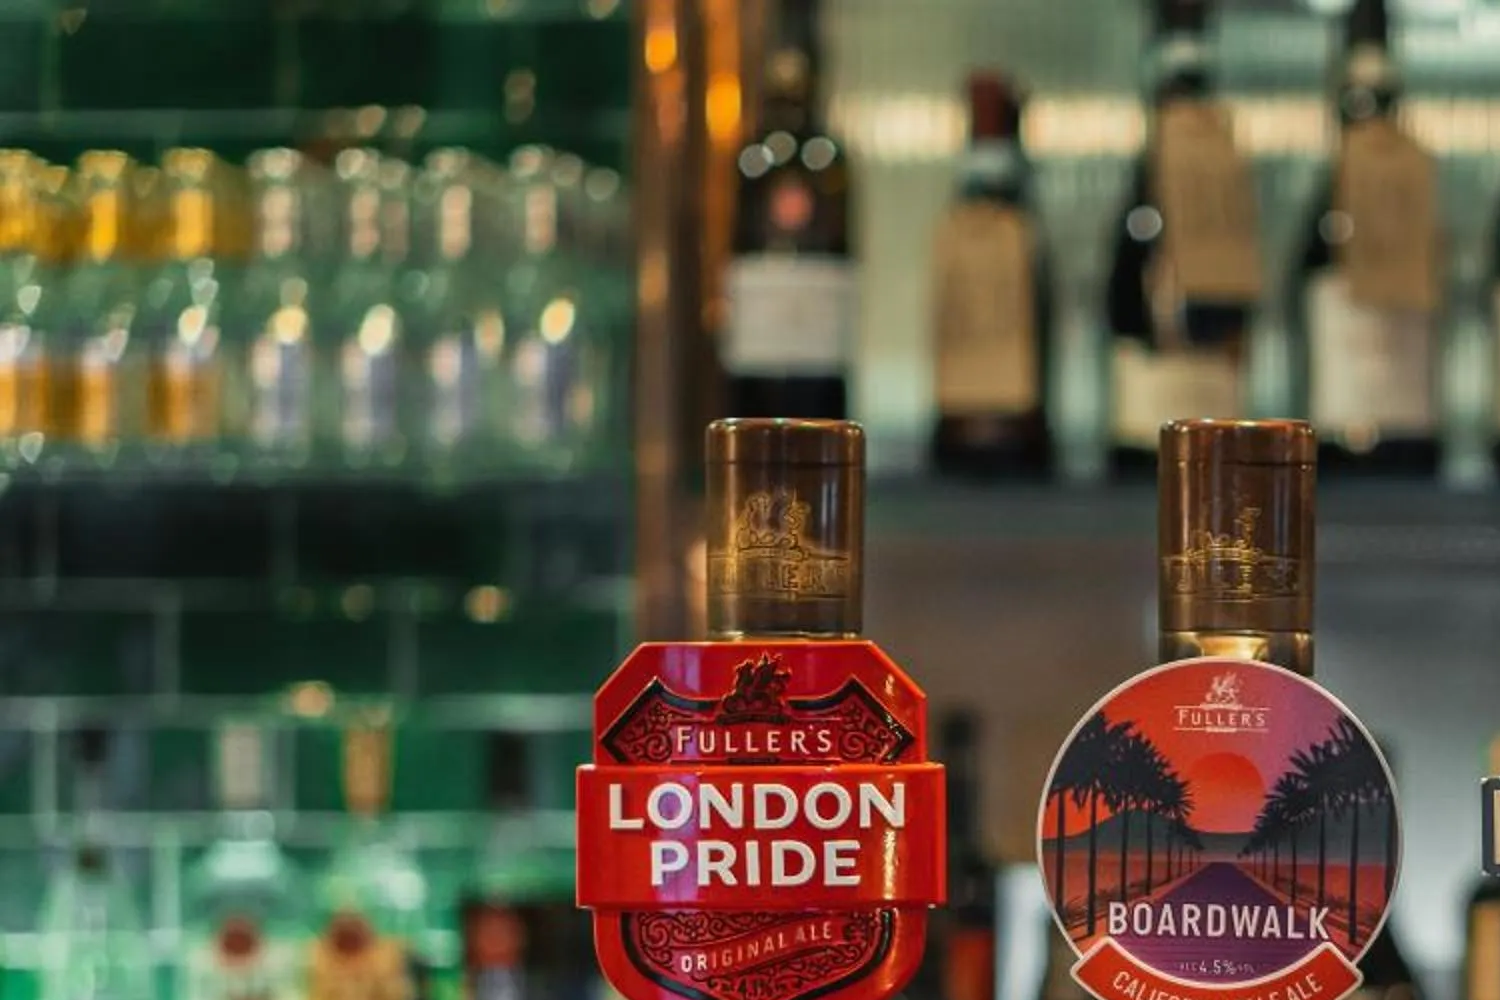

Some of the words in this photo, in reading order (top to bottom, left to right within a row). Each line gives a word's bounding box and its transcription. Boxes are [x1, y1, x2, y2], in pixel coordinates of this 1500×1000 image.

[676, 724, 834, 755] FULLER'S
[607, 782, 906, 831] LONDON
[650, 839, 862, 888] PRIDE
[1108, 902, 1331, 940] BOARDWALK
[681, 931, 788, 973] ORIGINAL
[795, 921, 833, 942] ALE
[1198, 959, 1236, 976] 4.5%
